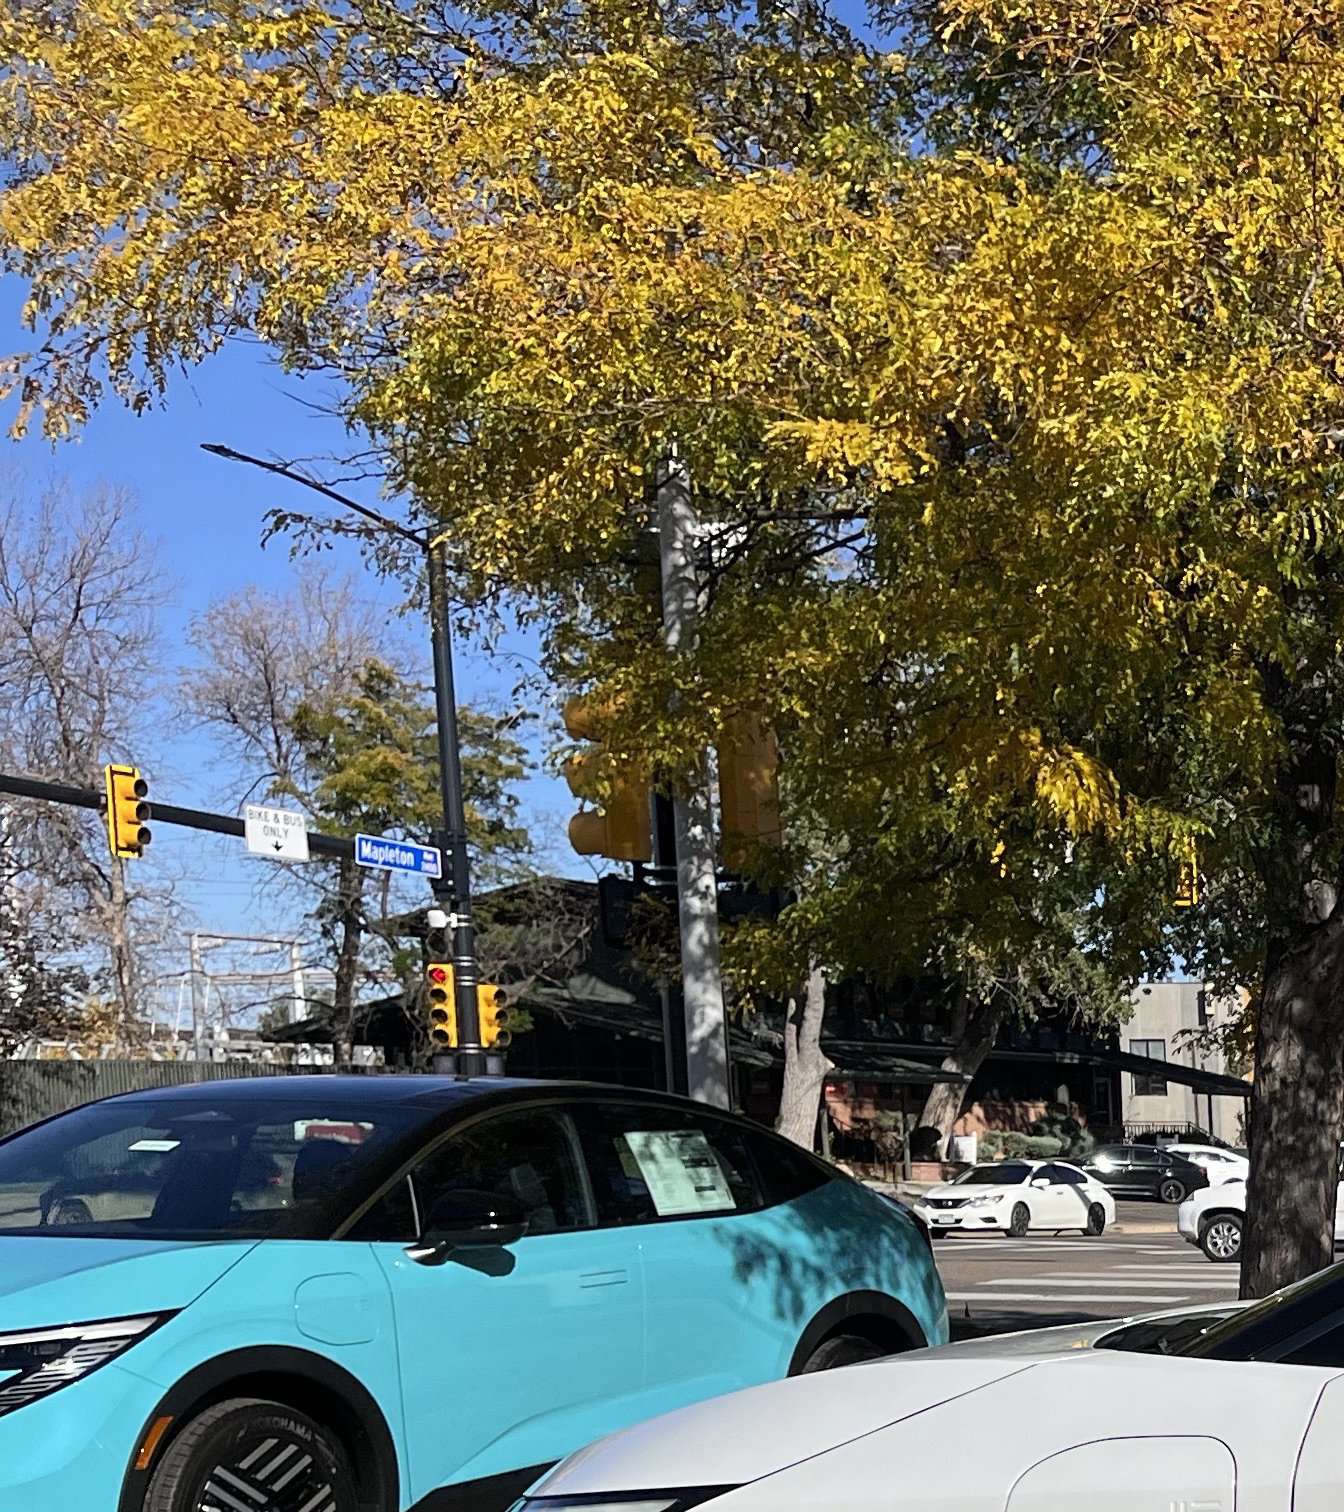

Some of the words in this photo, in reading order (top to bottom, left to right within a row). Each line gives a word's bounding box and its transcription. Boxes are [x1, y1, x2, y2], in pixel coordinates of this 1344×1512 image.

[248, 809, 272, 823] BIKE
[273, 812, 280, 824] &
[284, 813, 302, 827] BUS
[263, 826, 289, 839] ONLY
[360, 839, 415, 868] Mapleton
